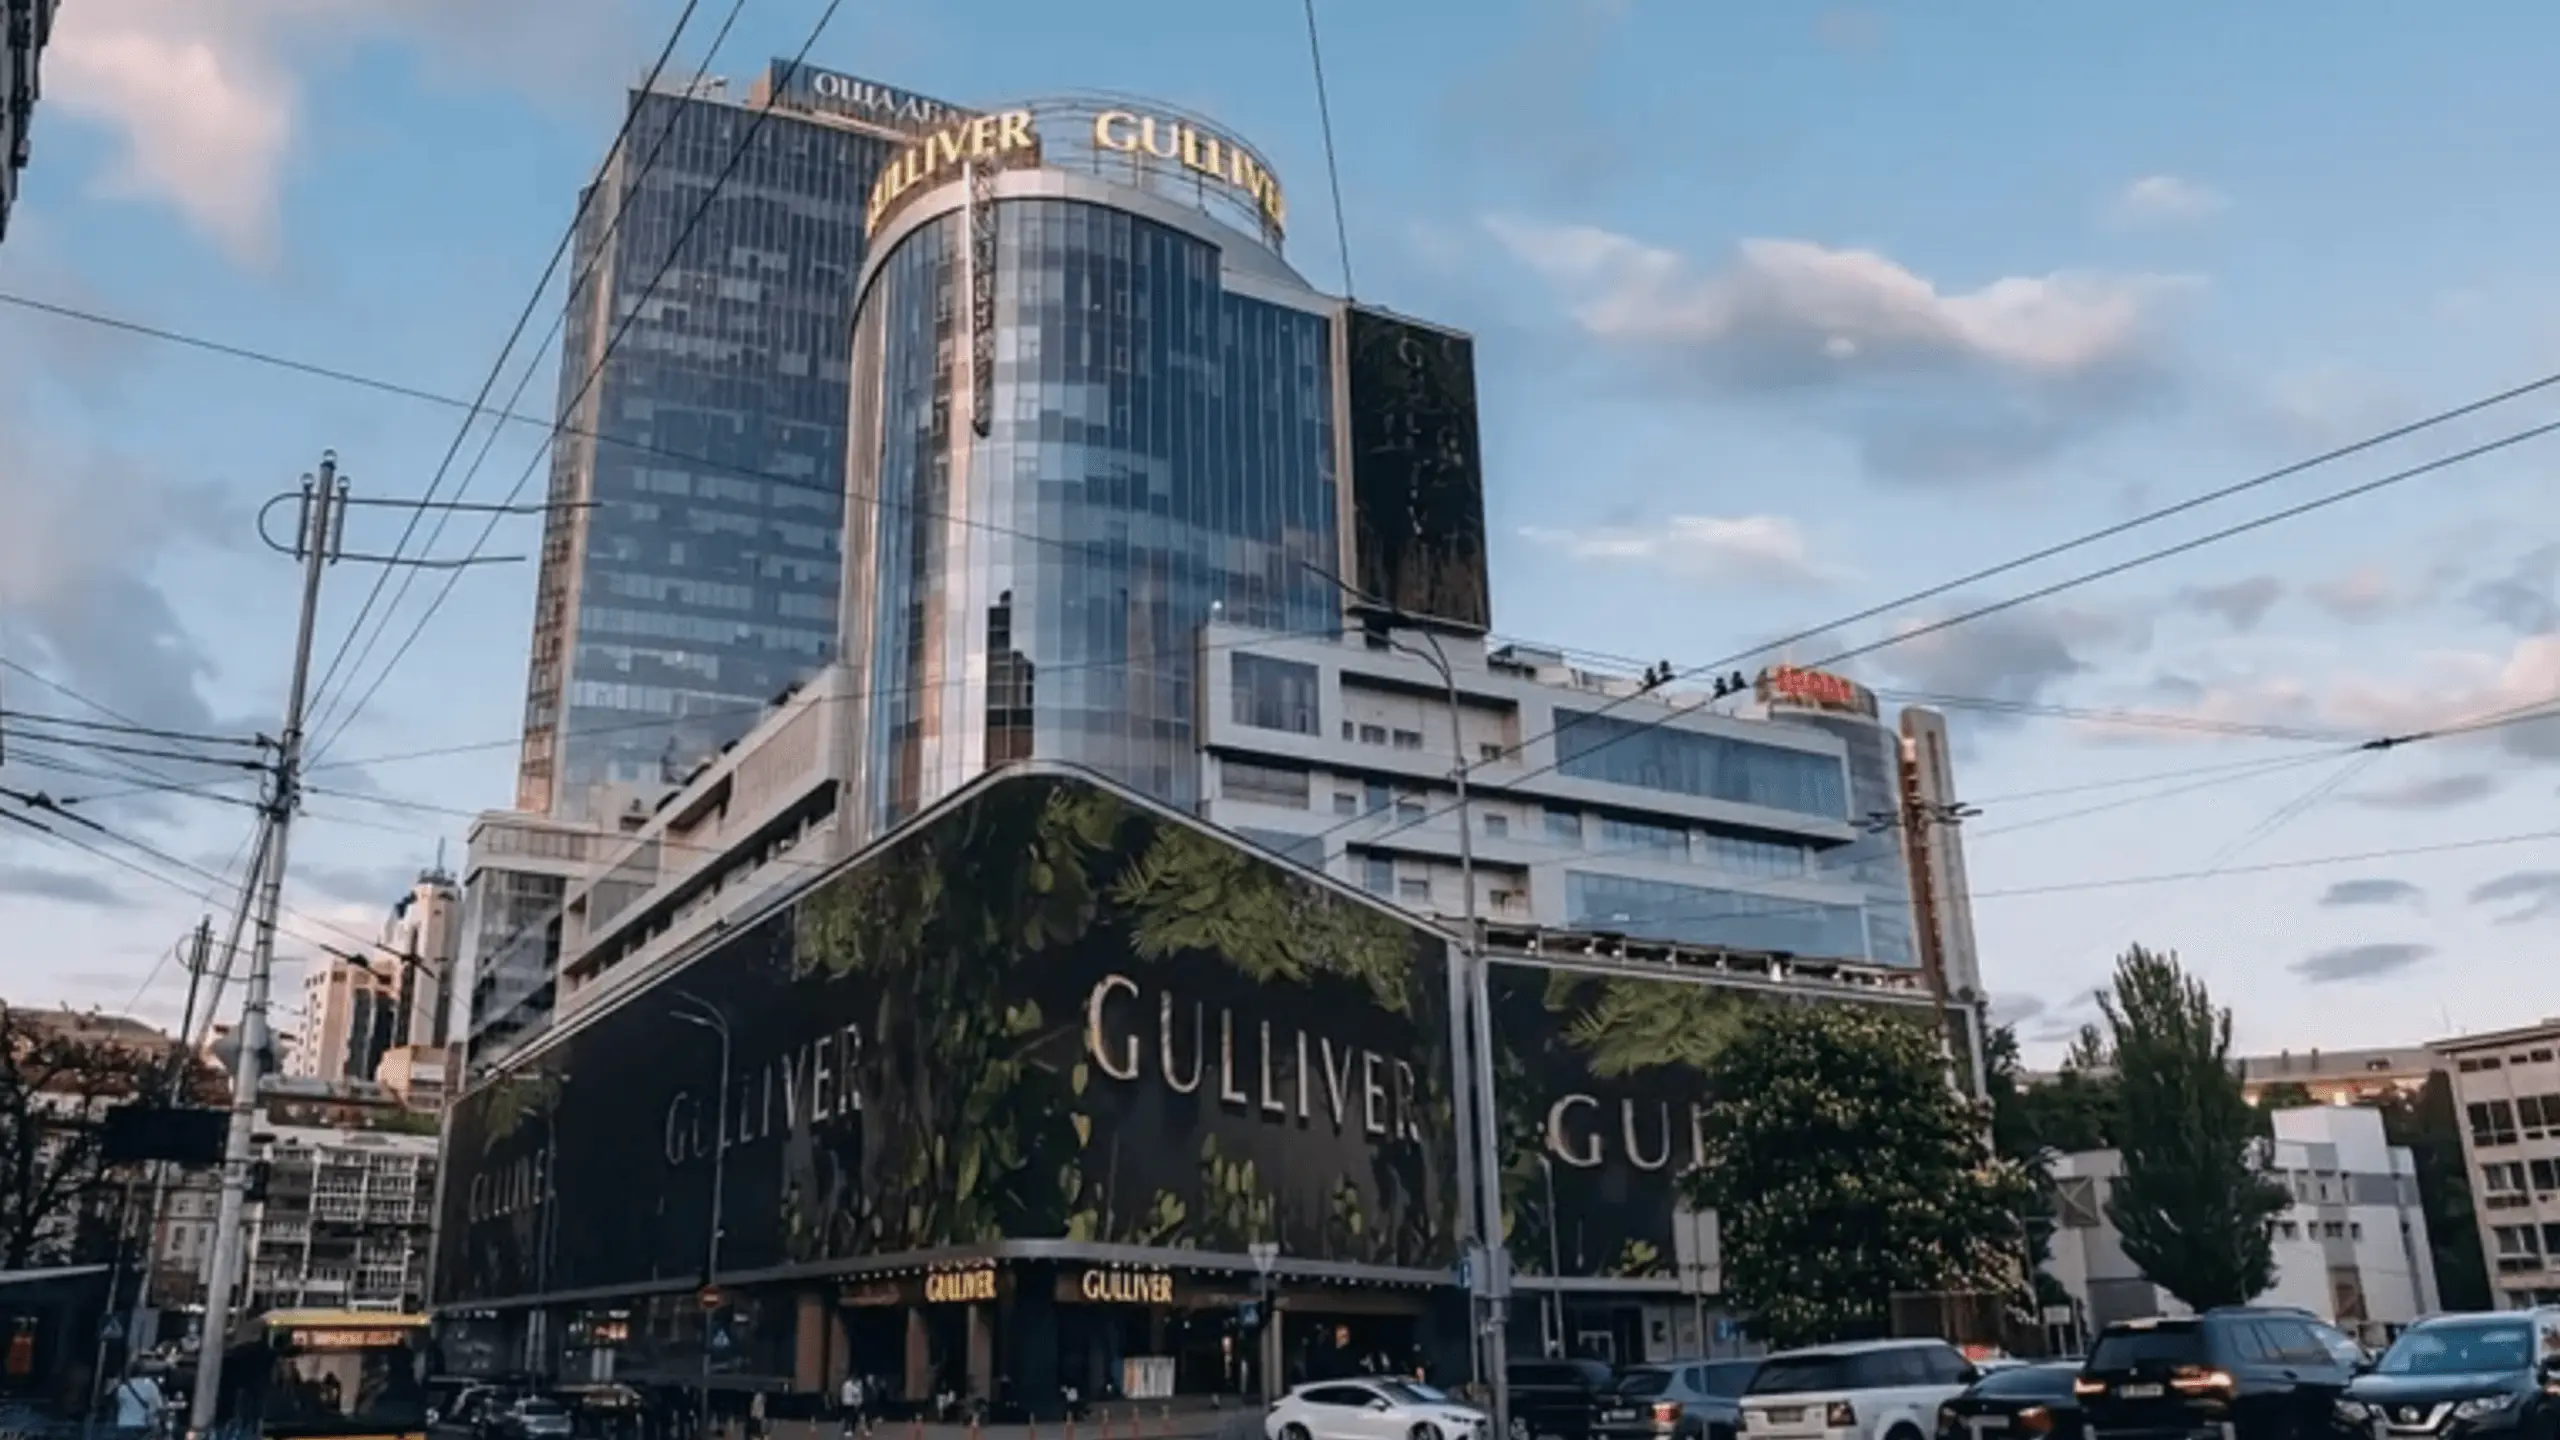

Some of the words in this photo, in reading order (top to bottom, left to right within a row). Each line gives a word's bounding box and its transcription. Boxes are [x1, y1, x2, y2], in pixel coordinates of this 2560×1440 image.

[1087, 973, 1420, 1145] GULLIVER
[925, 1269, 997, 1302] GULLIVER
[1082, 1269, 1173, 1304] GULLIVER
